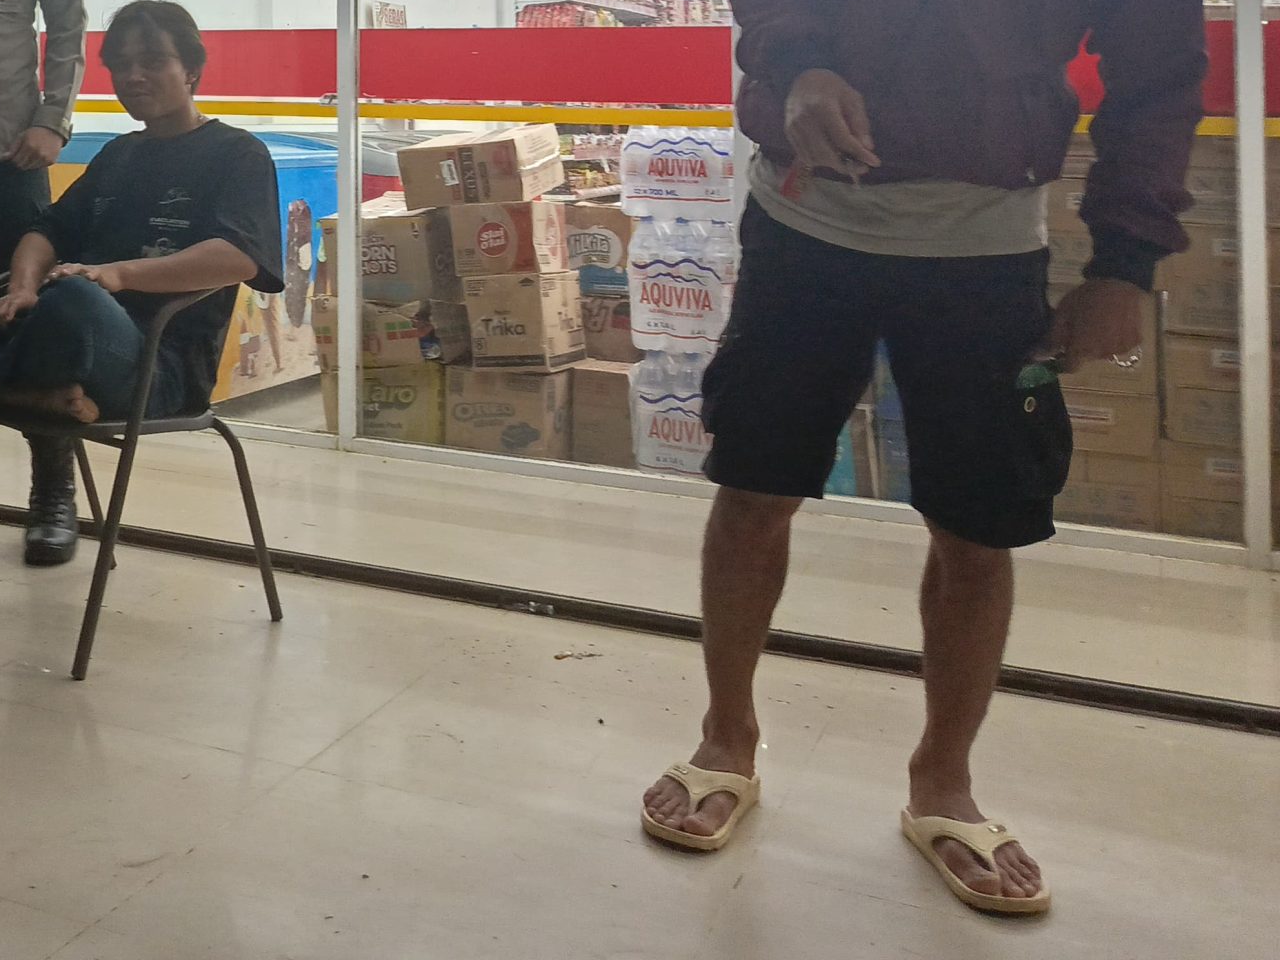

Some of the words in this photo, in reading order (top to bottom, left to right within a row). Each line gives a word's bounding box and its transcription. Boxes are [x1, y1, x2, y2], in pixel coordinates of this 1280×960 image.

[647, 158, 708, 178] AQUVIVA
[361, 244, 396, 261] ORN
[640, 281, 714, 312] AQUVIVA
[648, 416, 713, 445] AQUVI
